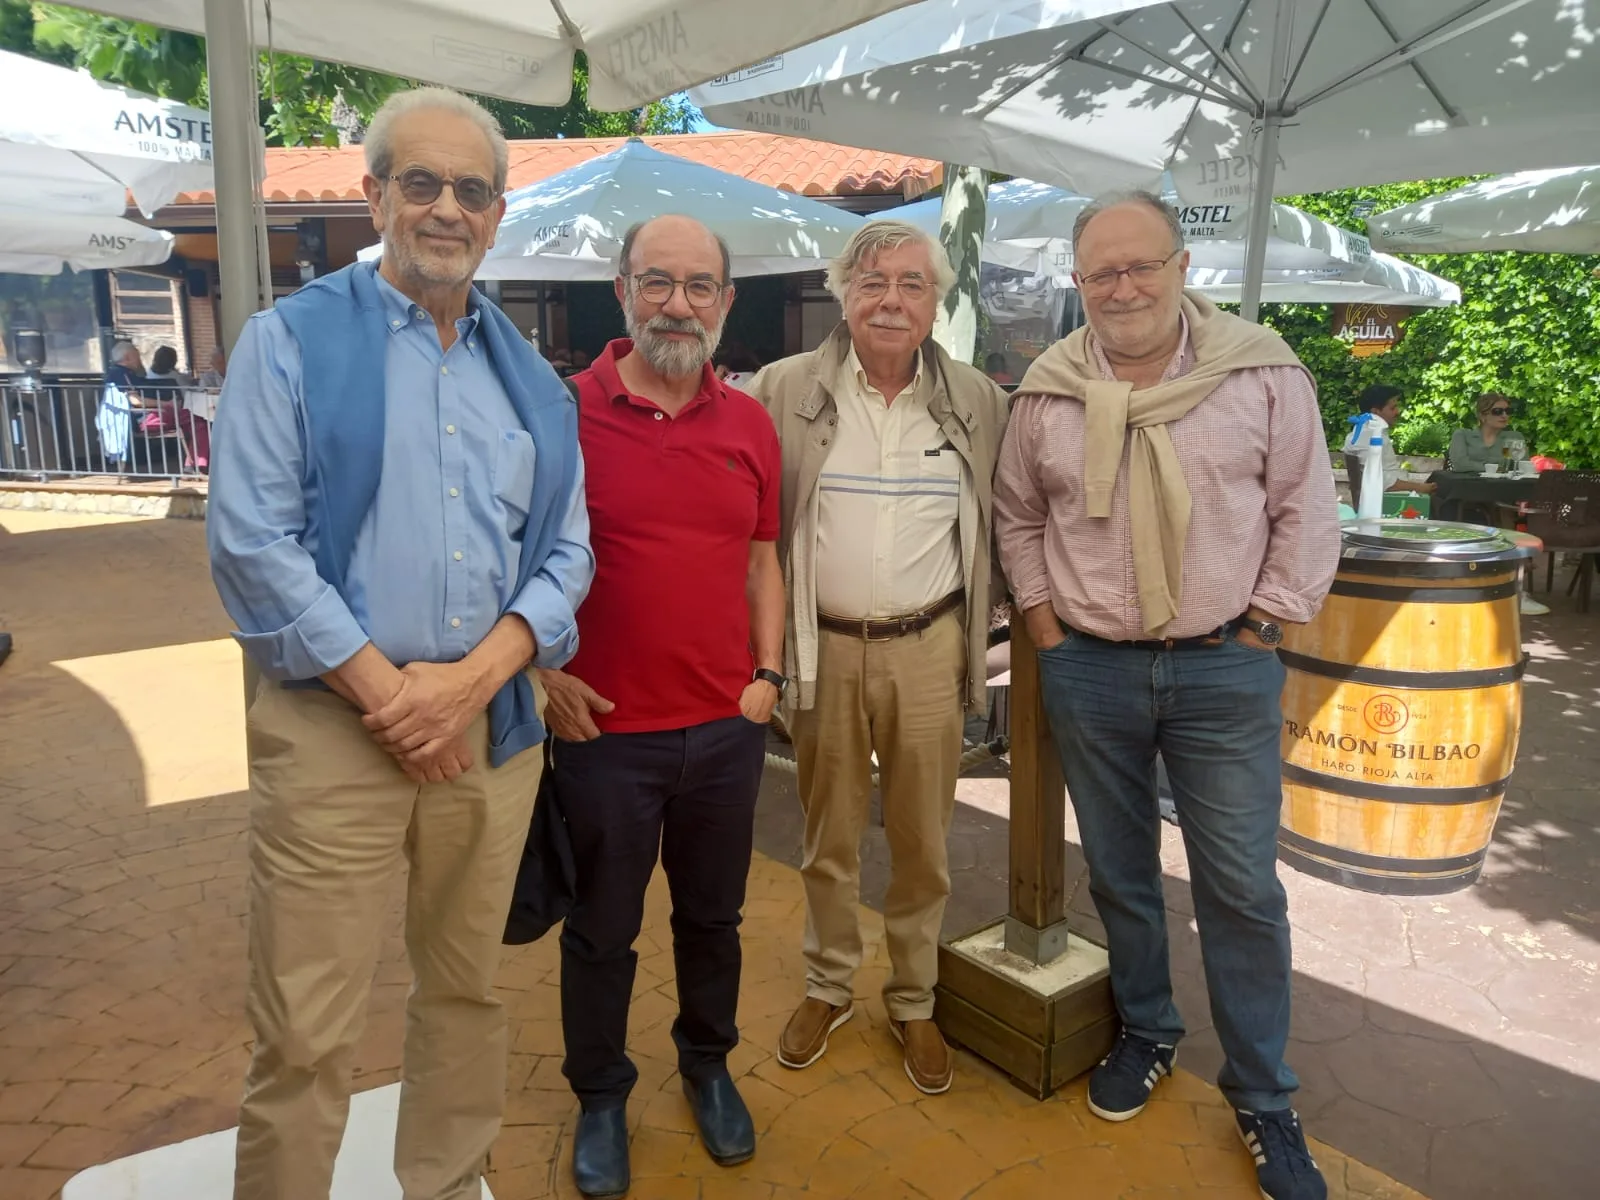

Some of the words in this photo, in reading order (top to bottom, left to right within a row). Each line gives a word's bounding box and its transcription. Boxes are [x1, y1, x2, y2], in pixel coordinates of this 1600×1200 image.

[1189, 227, 1215, 236] MALTA
[1286, 719, 1378, 756] RAMÓN
[1385, 742, 1481, 761] BILBAO
[1321, 757, 1356, 773] HARO
[1362, 768, 1400, 780] RIOJA
[1405, 773, 1434, 782] ALTA
